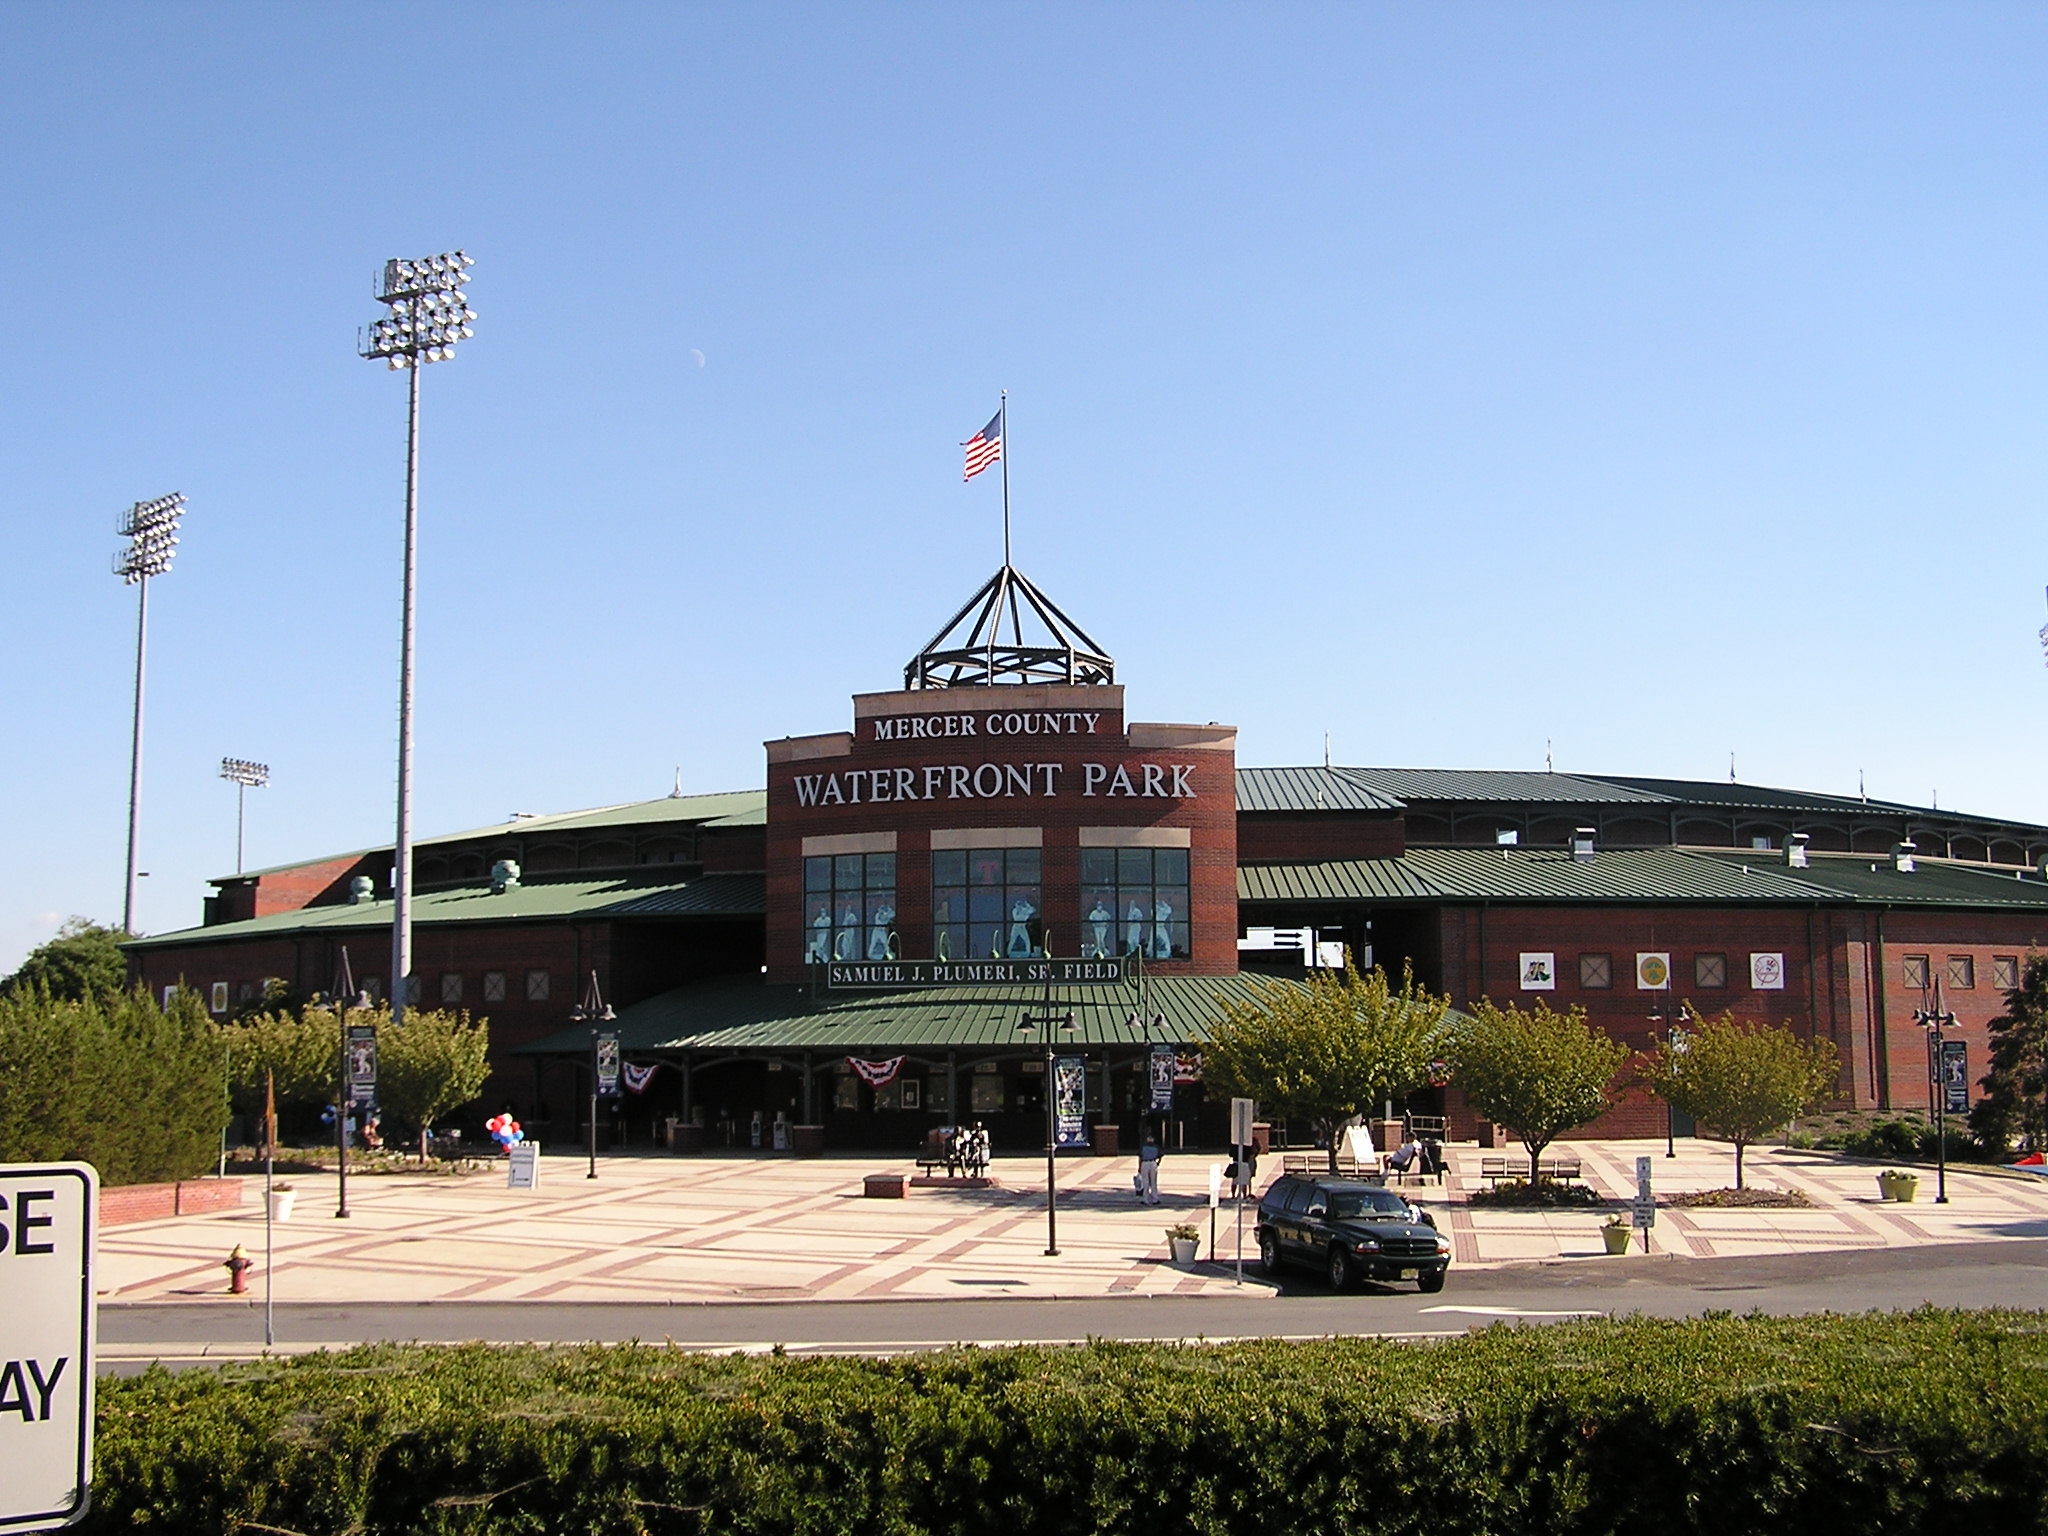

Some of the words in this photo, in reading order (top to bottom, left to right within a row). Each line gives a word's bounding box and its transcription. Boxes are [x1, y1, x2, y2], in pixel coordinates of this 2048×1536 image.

[874, 715, 977, 741] MERCER
[986, 713, 1100, 735] COUNTY
[793, 763, 1062, 807] WATERFRONT
[1082, 763, 1197, 798] PARK
[832, 966, 905, 982] SAMUEL
[912, 966, 925, 981] J.
[933, 965, 1021, 982] PLUMERI,
[1064, 963, 1118, 979] FIELD
